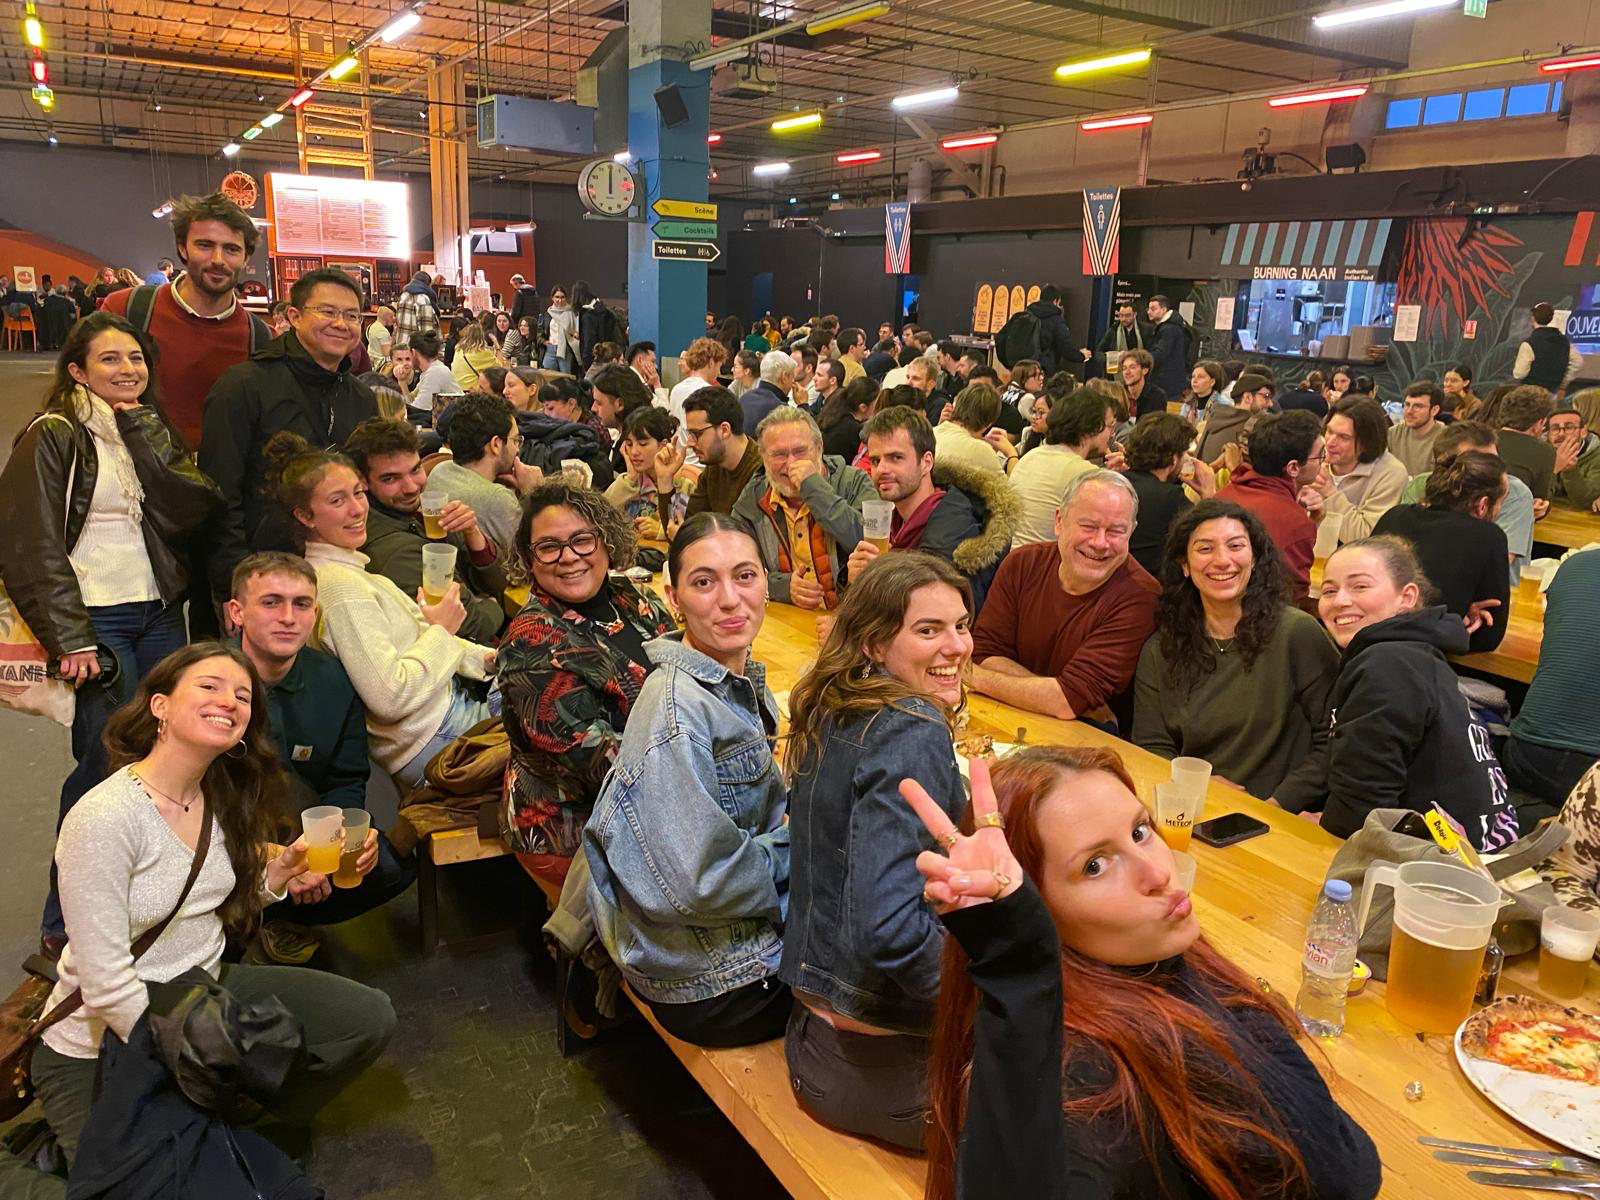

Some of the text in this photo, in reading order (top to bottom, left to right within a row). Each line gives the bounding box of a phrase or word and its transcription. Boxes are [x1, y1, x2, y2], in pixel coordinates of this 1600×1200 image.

[694, 206, 714, 215] Scène
[684, 226, 714, 235] Cocktails
[657, 245, 687, 255] Toilettes
[1254, 267, 1336, 280] BURNING NAAN
[1567, 315, 1600, 336] OUVE
[1304, 951, 1328, 966] vian
